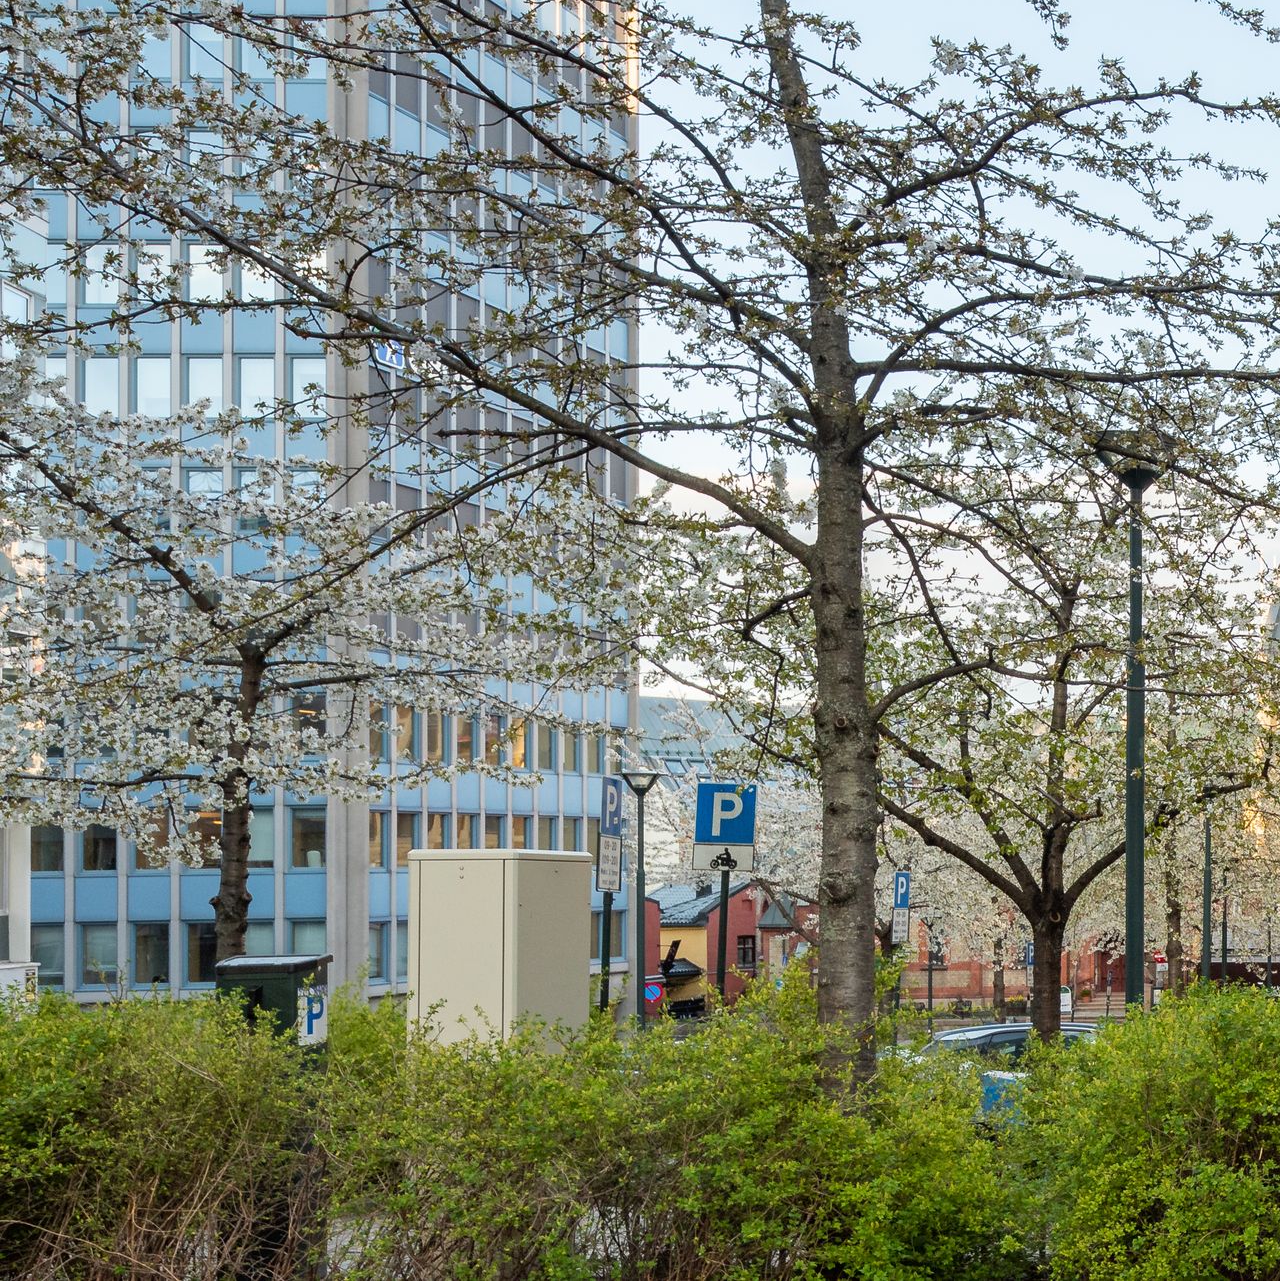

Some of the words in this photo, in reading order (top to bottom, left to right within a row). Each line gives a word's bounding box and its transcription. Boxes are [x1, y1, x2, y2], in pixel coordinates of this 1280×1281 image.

[606, 785, 618, 828] P
[712, 792, 743, 836] P
[898, 877, 907, 904] P
[307, 996, 324, 1035] P
